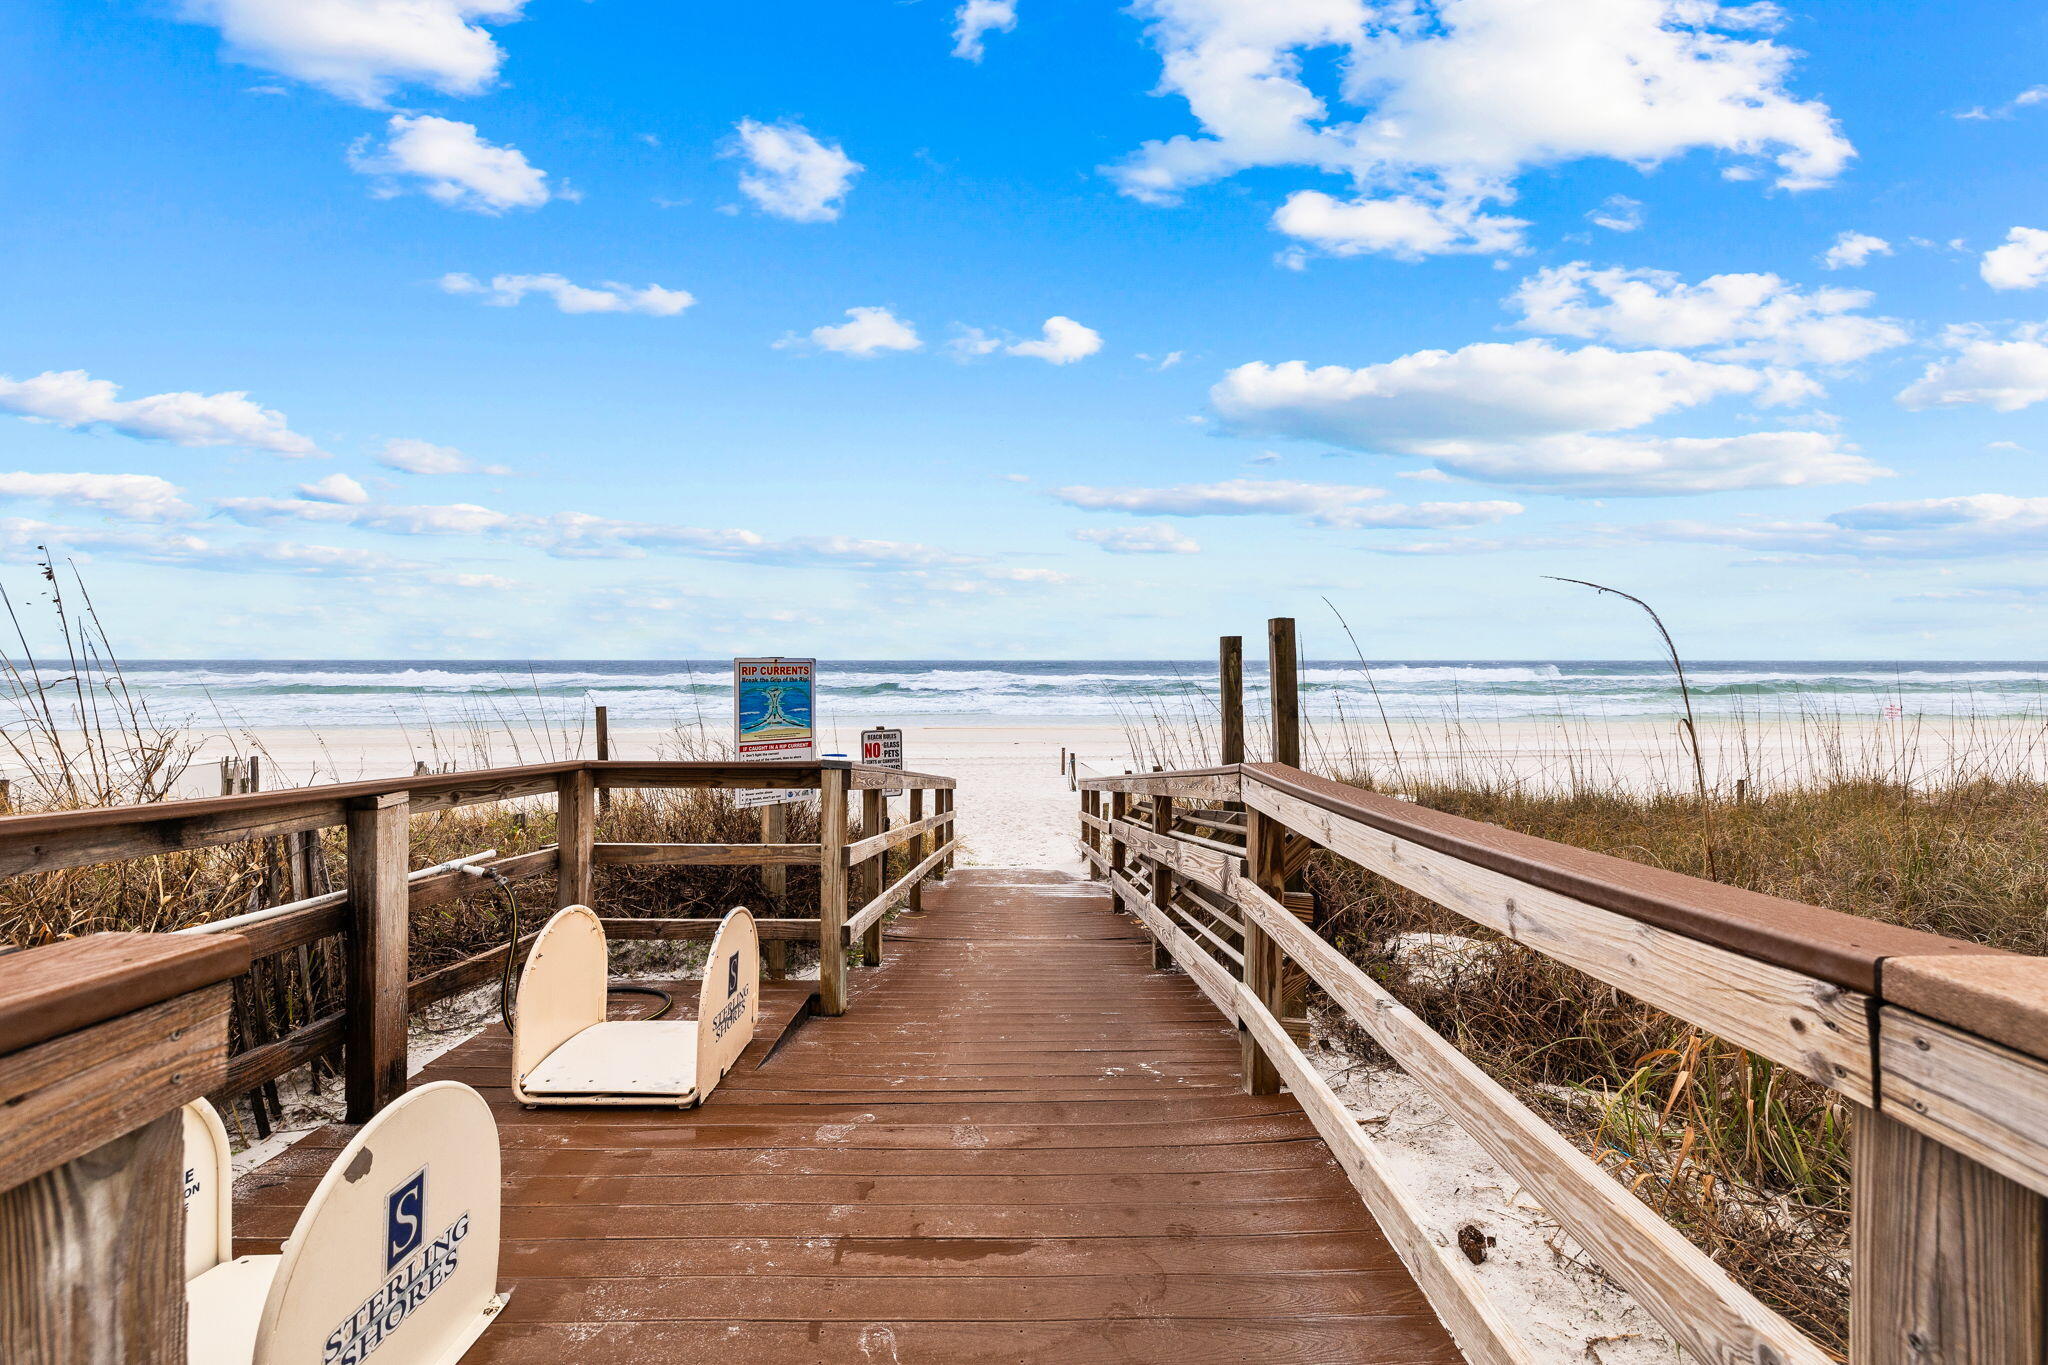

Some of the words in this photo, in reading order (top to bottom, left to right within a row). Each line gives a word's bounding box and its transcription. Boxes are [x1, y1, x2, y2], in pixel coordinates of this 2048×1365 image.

[742, 666, 757, 675] RIP
[760, 666, 809, 675] CURRENTS
[865, 742, 880, 758] NO
[712, 983, 749, 1031] STERLING
[716, 1000, 746, 1043] SHORES
[392, 1184, 418, 1258] S
[324, 1212, 469, 1364] STERLING
[341, 1250, 458, 1365] SHORES
